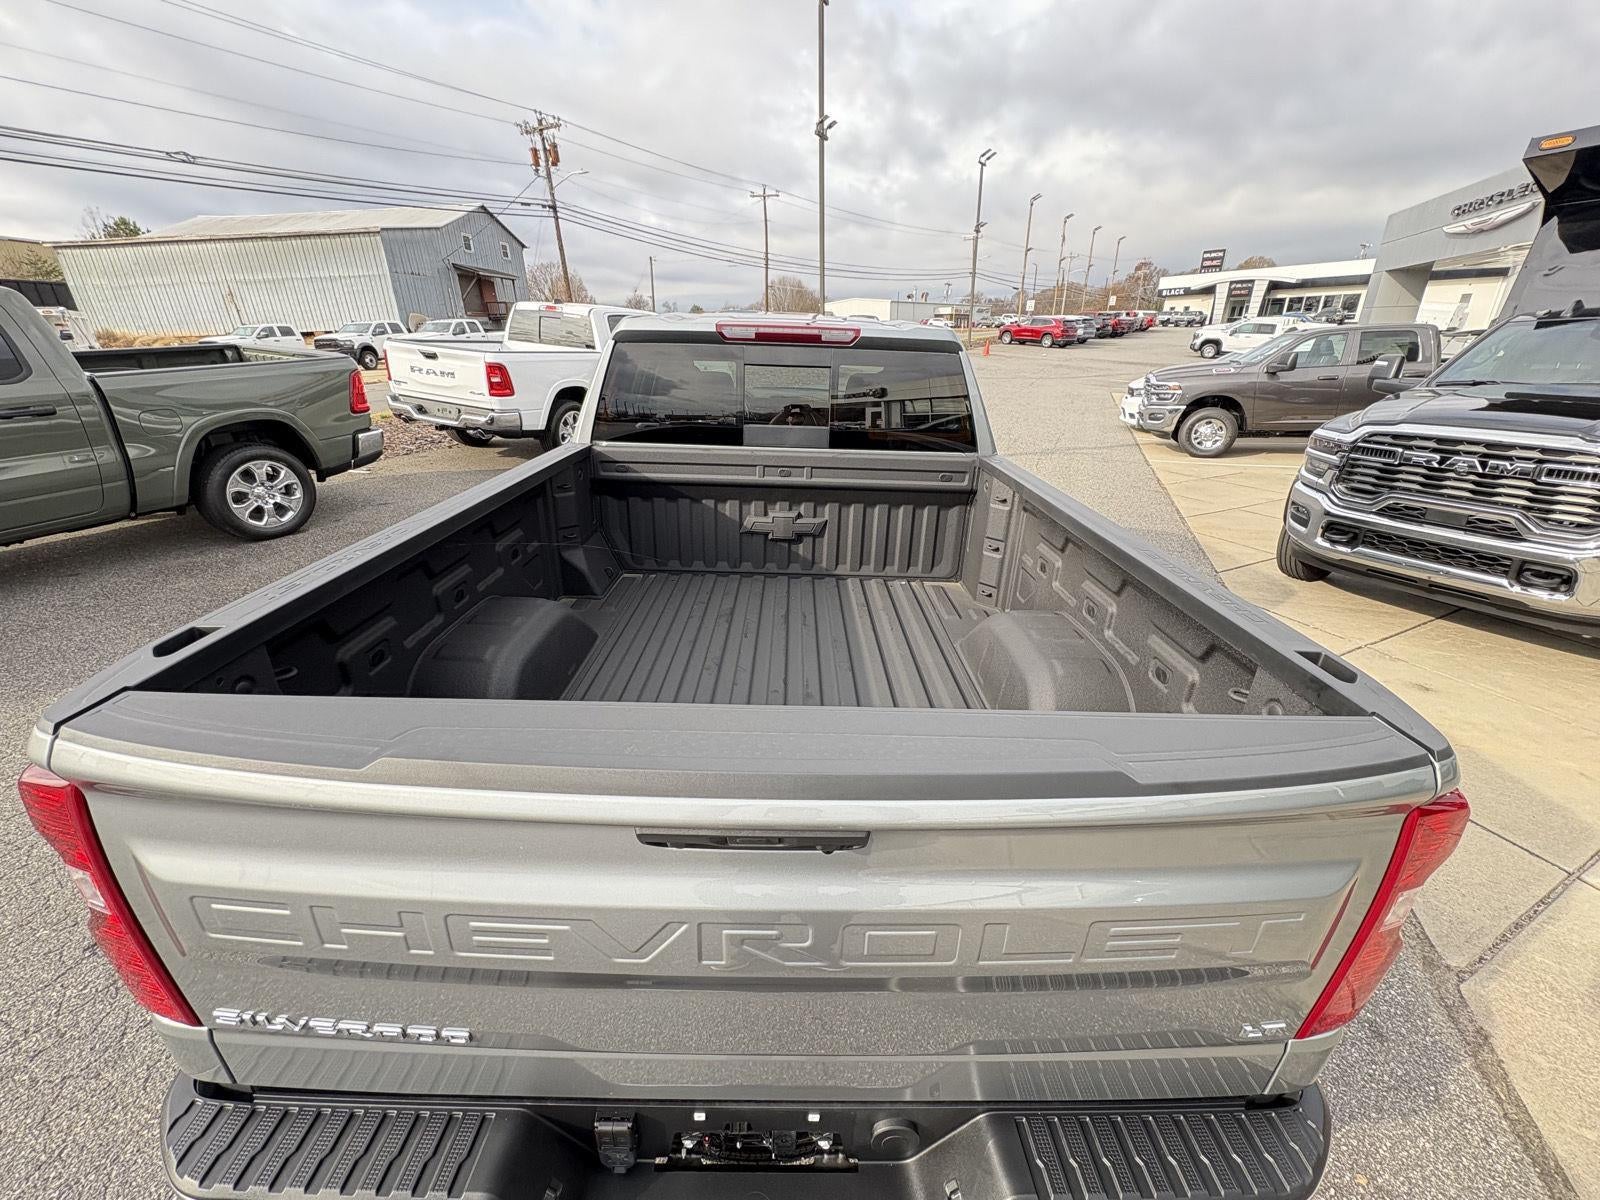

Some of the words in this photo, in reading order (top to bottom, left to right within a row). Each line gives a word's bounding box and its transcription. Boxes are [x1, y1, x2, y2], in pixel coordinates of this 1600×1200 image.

[1162, 288, 1185, 296] BLACK
[410, 365, 456, 379] RAM
[1402, 449, 1536, 480] RAM
[190, 895, 1307, 966] CHEVROLET
[211, 1007, 473, 1045] SILVERADO
[1241, 1020, 1286, 1038] LT
